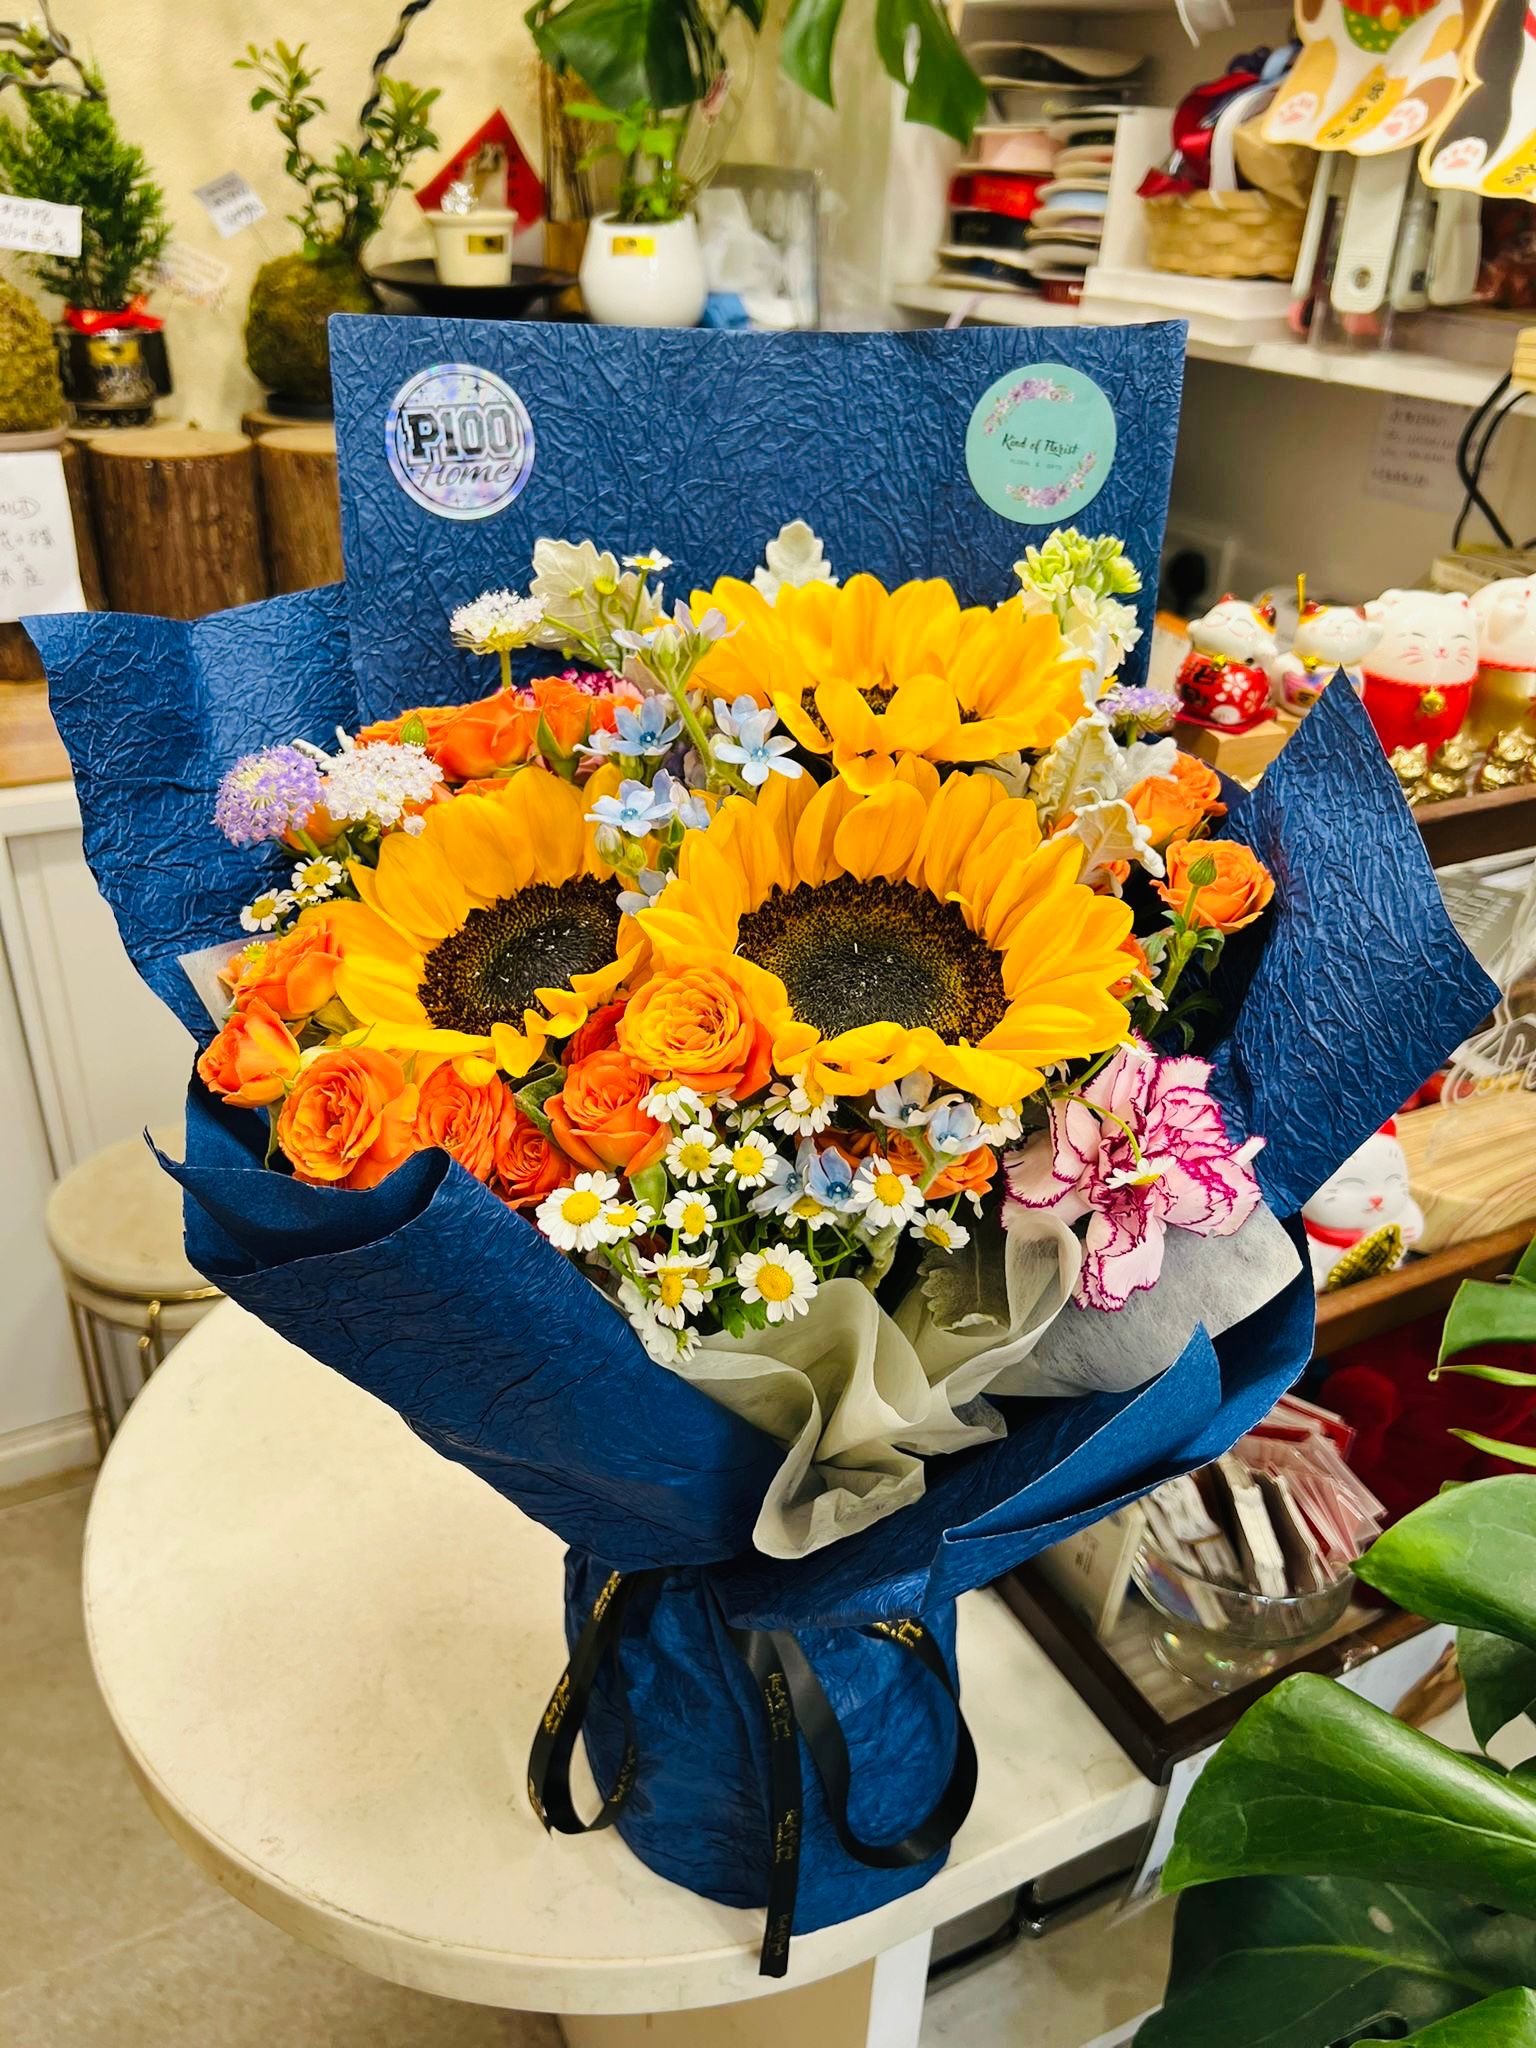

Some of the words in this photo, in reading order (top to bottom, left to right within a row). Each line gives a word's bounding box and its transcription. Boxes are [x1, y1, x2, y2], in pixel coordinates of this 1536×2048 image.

[402, 404, 519, 466] P100
[1030, 439, 1042, 454] of
[419, 461, 512, 488] Home
